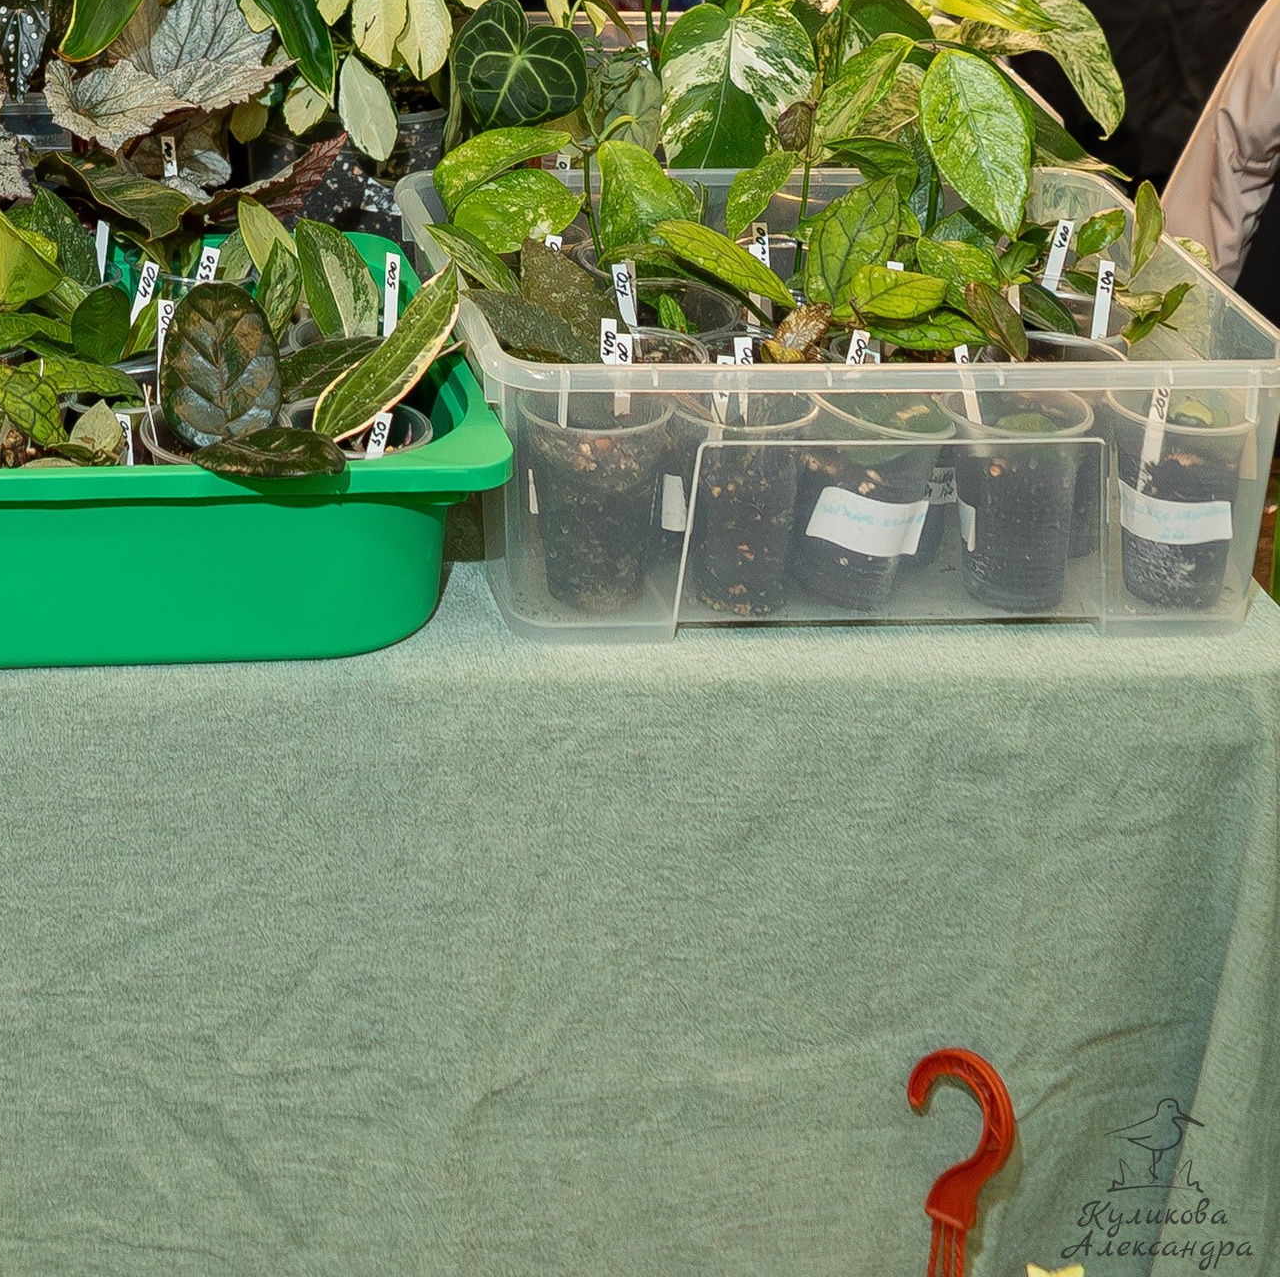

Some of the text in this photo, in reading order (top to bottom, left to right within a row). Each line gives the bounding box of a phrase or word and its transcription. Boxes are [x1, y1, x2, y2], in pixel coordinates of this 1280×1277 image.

[1054, 225, 1069, 249] 400
[138, 266, 156, 298] 400
[603, 330, 616, 356] 400
